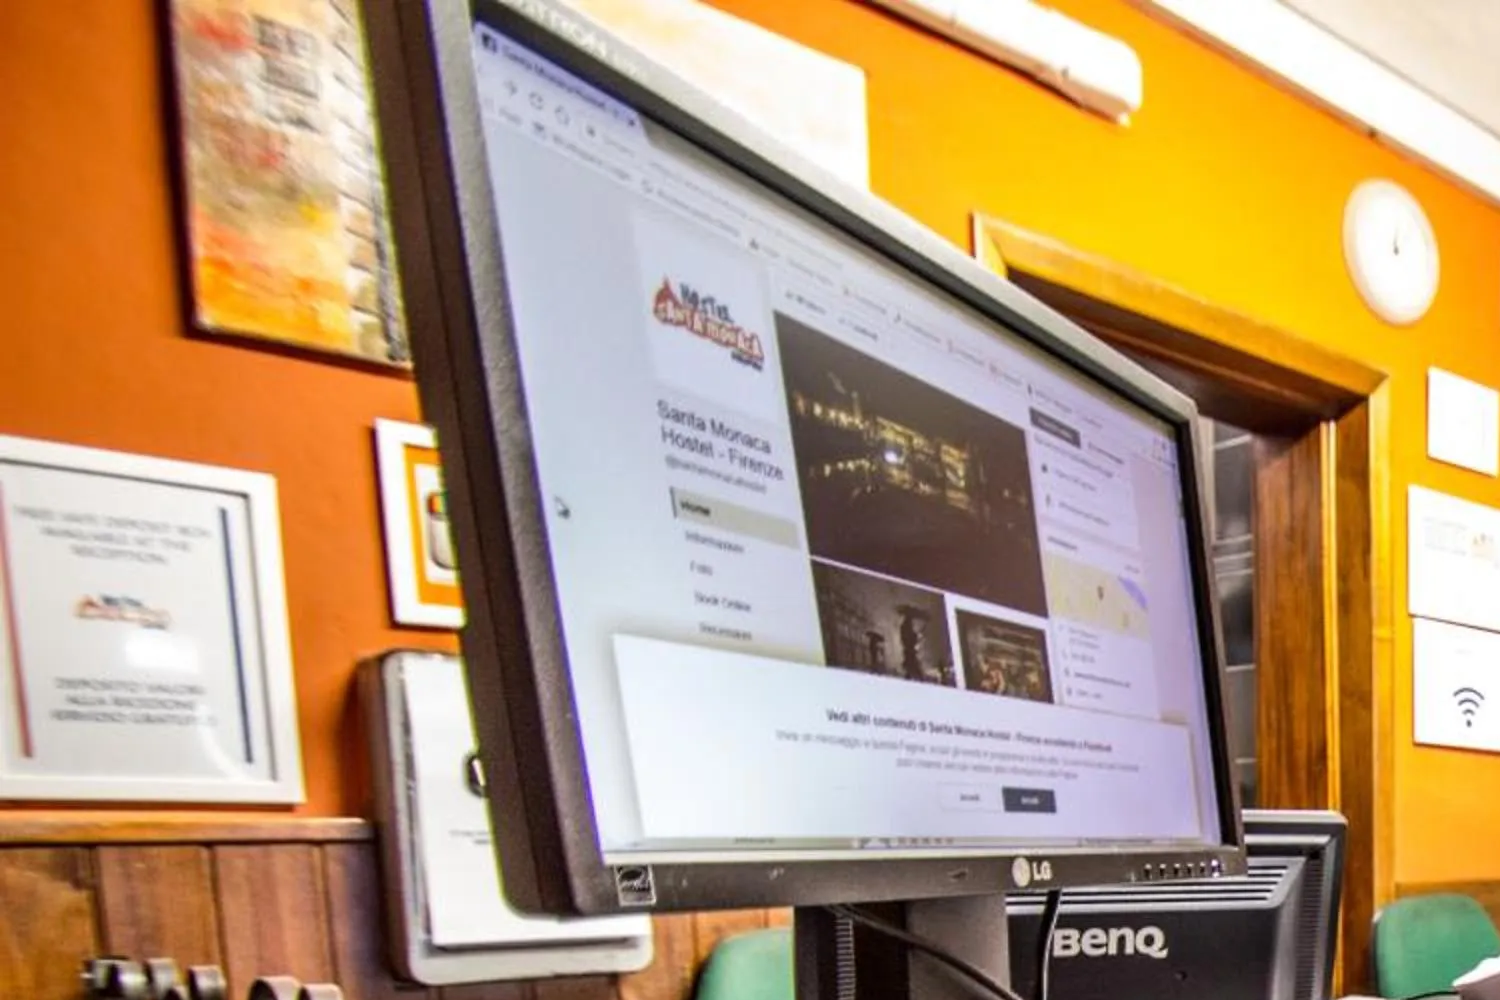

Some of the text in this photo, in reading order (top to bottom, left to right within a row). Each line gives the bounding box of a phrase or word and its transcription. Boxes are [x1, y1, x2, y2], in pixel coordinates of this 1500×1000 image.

[657, 399, 772, 454] Santa Monaca
[661, 425, 714, 459] Hostel
[728, 447, 785, 481] Firenze
[826, 708, 850, 724] Vedi
[1052, 925, 1169, 960] BenQ
